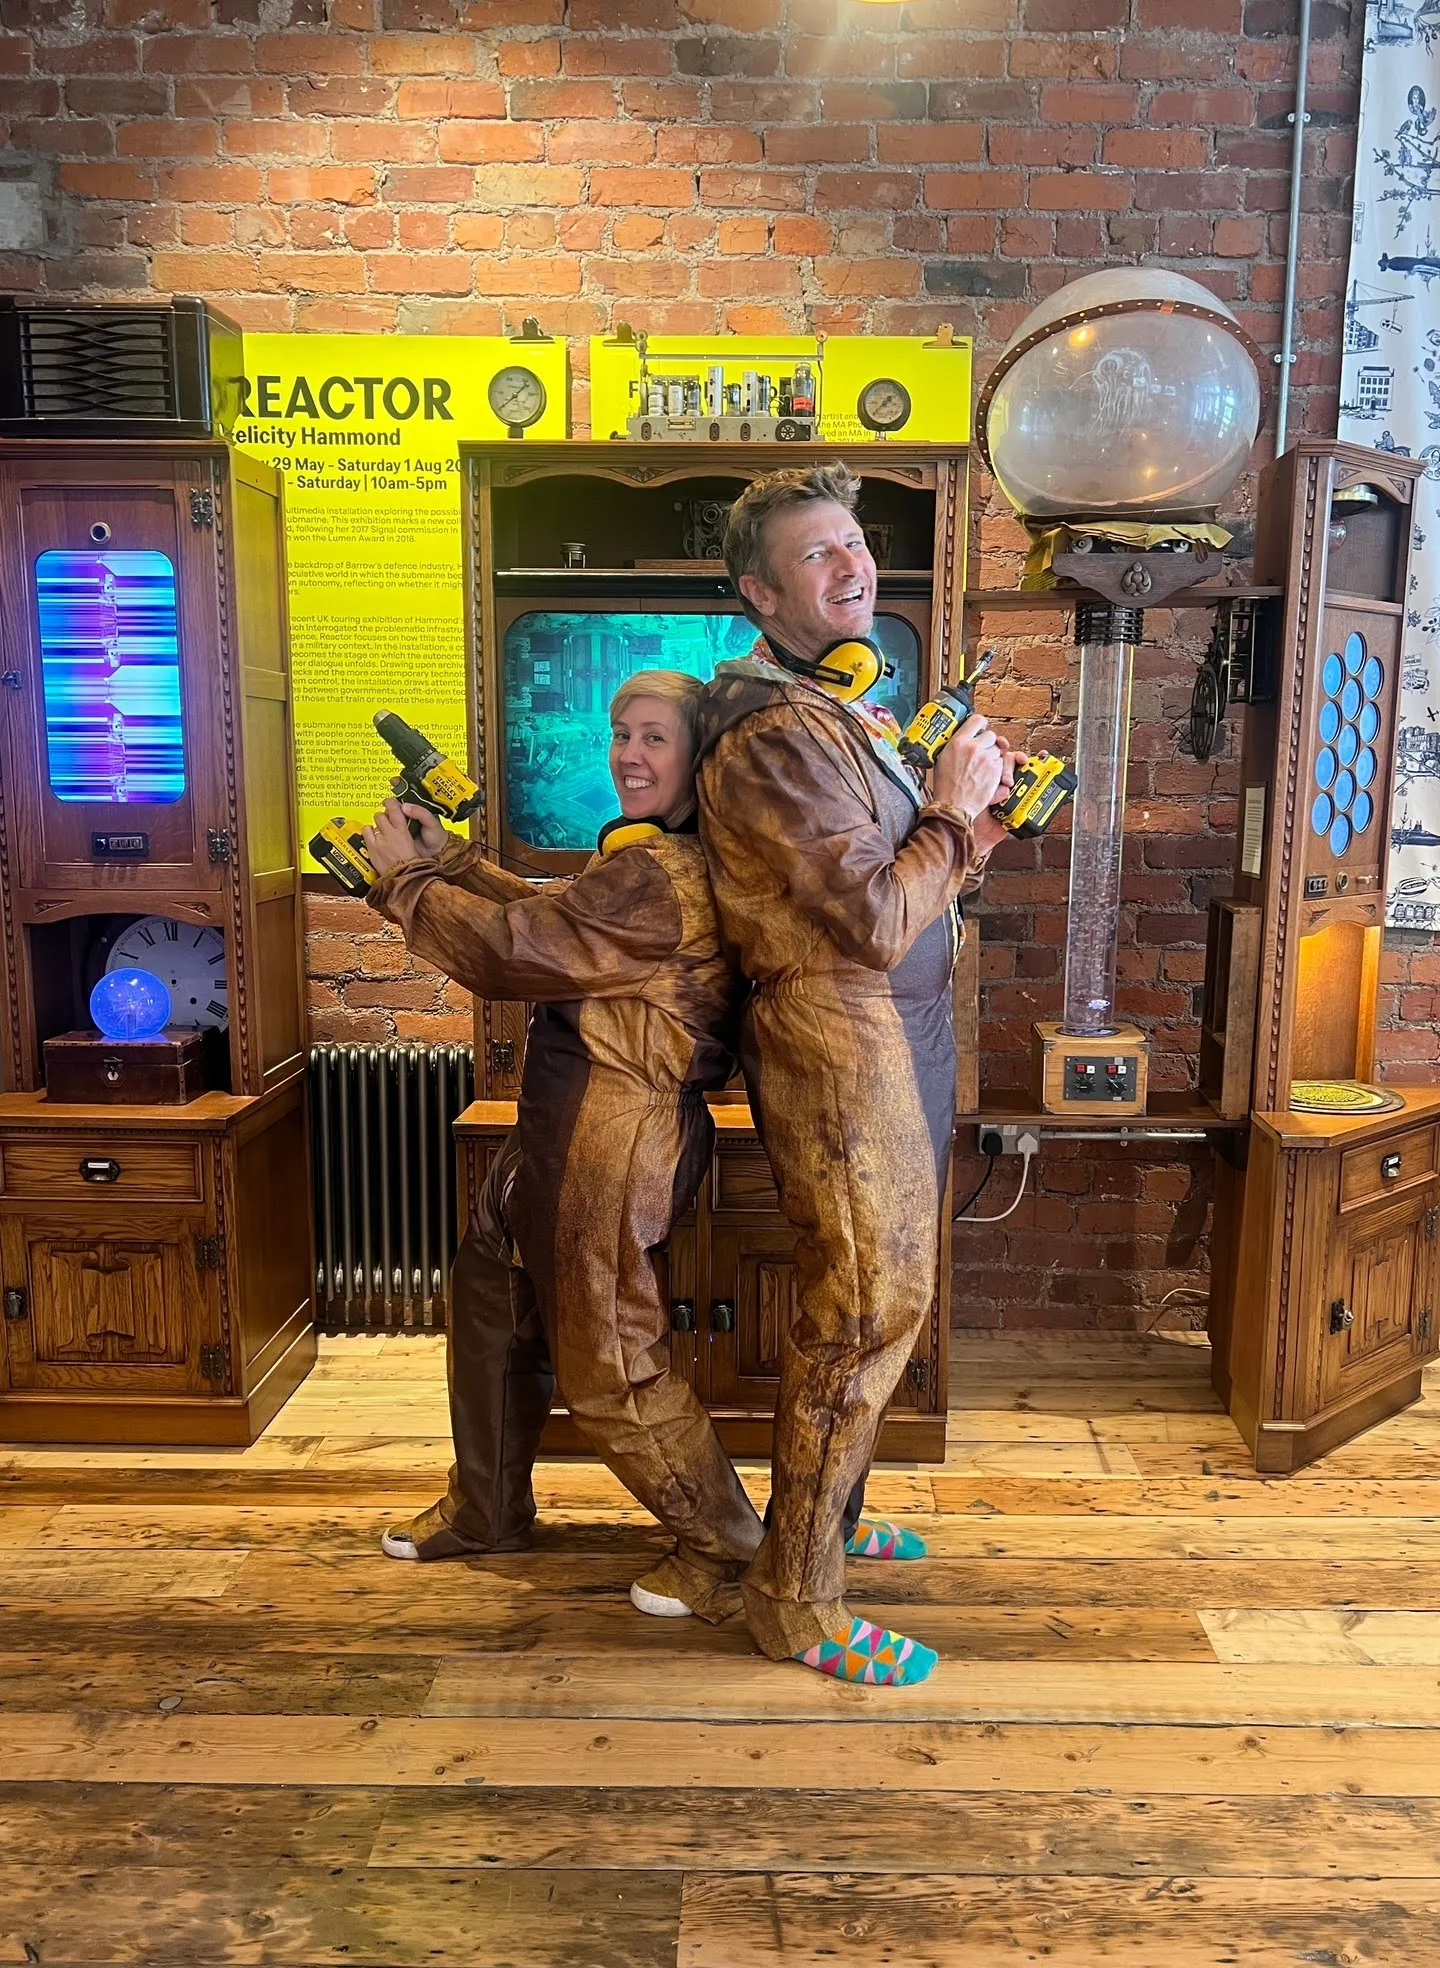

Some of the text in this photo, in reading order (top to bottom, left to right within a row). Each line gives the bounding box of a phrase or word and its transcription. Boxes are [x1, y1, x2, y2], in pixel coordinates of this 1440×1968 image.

[232, 425, 401, 449] elicity Hammond
[272, 456, 291, 471] 29
[295, 457, 325, 474] May
[337, 457, 402, 475] Saturday
[403, 458, 411, 472] 1
[414, 458, 442, 475] Aug
[296, 475, 447, 493] Saturday 10am-5pm
[327, 506, 373, 515] installation
[375, 507, 413, 517] exploring
[415, 507, 429, 516] the
[331, 515, 348, 524] This
[351, 515, 391, 524] exhibition
[393, 516, 419, 524] marks
[296, 524, 459, 535] following her 2017 Signal commission in
[312, 533, 326, 542] the
[328, 533, 356, 542] Lumen
[359, 534, 385, 542] Award
[387, 534, 394, 542] in
[396, 534, 416, 543] 2018.
[294, 560, 334, 571] backdrop
[335, 560, 344, 569] of
[384, 561, 417, 570] defence
[325, 570, 348, 578] world
[351, 570, 357, 578] in
[360, 570, 384, 579] which
[386, 570, 399, 579] the
[402, 570, 445, 579] submarine
[299, 579, 342, 589] autonomy,
[344, 579, 384, 589] reflecting
[398, 579, 432, 588] whether
[434, 580, 439, 588] it
[317, 614, 329, 623] UK
[331, 615, 360, 625] touring
[362, 615, 403, 623] exhibition
[405, 615, 413, 624] of
[306, 623, 425, 634] interrogated the problematic
[320, 632, 351, 641] Reactor
[354, 632, 387, 641] focuses
[401, 633, 418, 641] how
[420, 633, 435, 642] this
[306, 641, 336, 651] military
[339, 642, 372, 650] context.
[375, 641, 382, 650] In
[384, 641, 398, 650] the
[329, 650, 342, 658] the
[344, 651, 367, 661] stage
[382, 650, 405, 659] which
[408, 651, 421, 659] the
[308, 658, 343, 669] dialogue
[345, 659, 378, 668] unfolds.
[380, 659, 413, 670] Drawing
[415, 662, 437, 670] upon
[314, 667, 329, 676] and
[332, 668, 345, 676] the
[370, 669, 429, 679] contemporary
[308, 676, 340, 686] control,
[341, 677, 355, 685] the
[357, 677, 402, 686] installation
[404, 678, 429, 686] draws
[303, 685, 451, 697] between governments, profit-driven
[302, 693, 325, 702] those
[327, 694, 344, 702] that
[346, 695, 364, 703] train
[377, 695, 409, 705] operate
[411, 695, 434, 704] these
[303, 720, 346, 729] submarine
[348, 721, 362, 729] has
[431, 722, 464, 733] through
[315, 729, 343, 740] people
[316, 738, 370, 747] submarine to
[330, 747, 358, 755] before.
[361, 747, 380, 756] This
[315, 755, 336, 766] really
[369, 756, 377, 765] to
[379, 756, 388, 765] be
[311, 763, 324, 772] the
[326, 764, 369, 772] submarine
[353, 772, 380, 781] worker
[327, 781, 377, 790] exhibition at
[326, 790, 371, 801] history and
[302, 798, 340, 807] industrial
